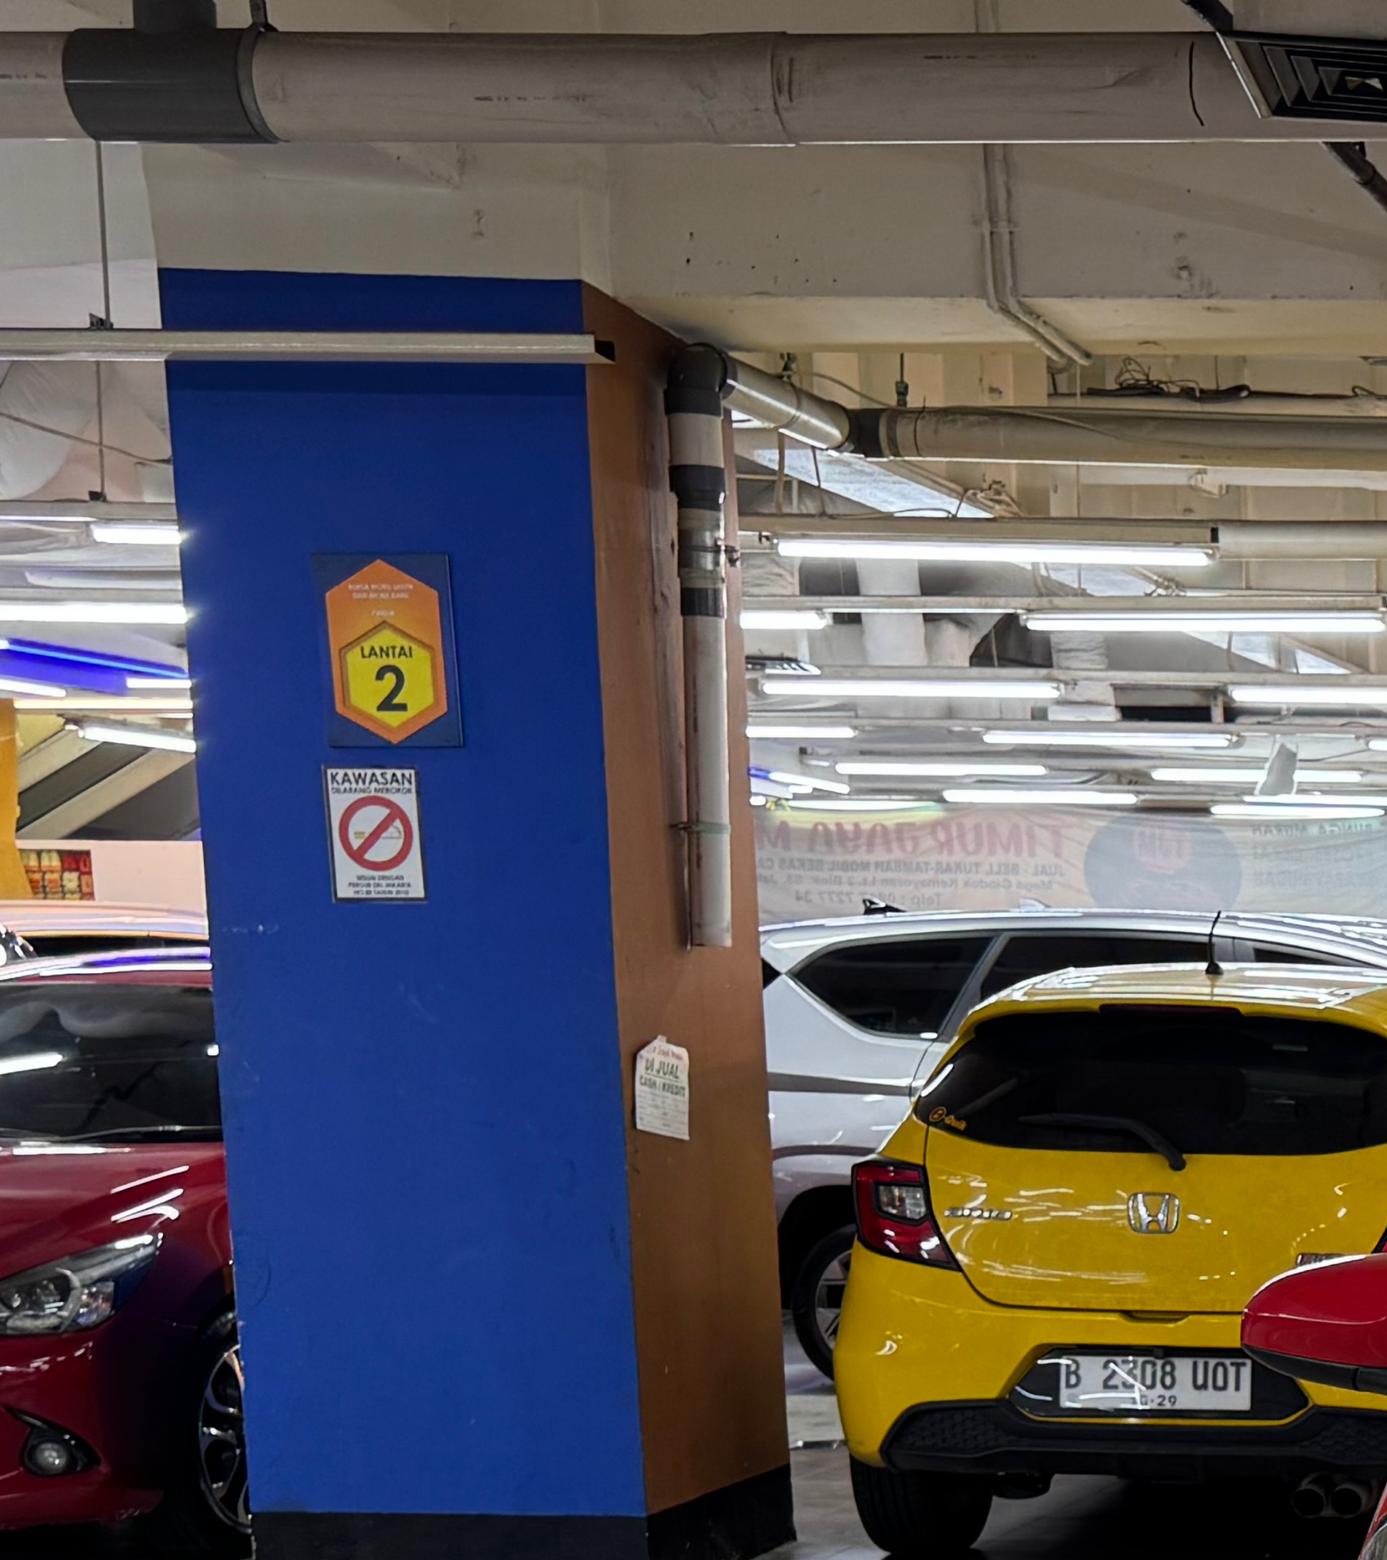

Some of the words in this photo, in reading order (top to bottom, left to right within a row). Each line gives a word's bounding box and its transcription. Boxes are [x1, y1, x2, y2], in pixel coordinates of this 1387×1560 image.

[360, 646, 413, 659] LANTAI
[375, 664, 408, 712] 2
[330, 771, 413, 786] KAWASAN
[656, 1061, 680, 1080] JUAL
[1065, 1358, 1082, 1389] B
[1102, 1358, 1177, 1390] 2308
